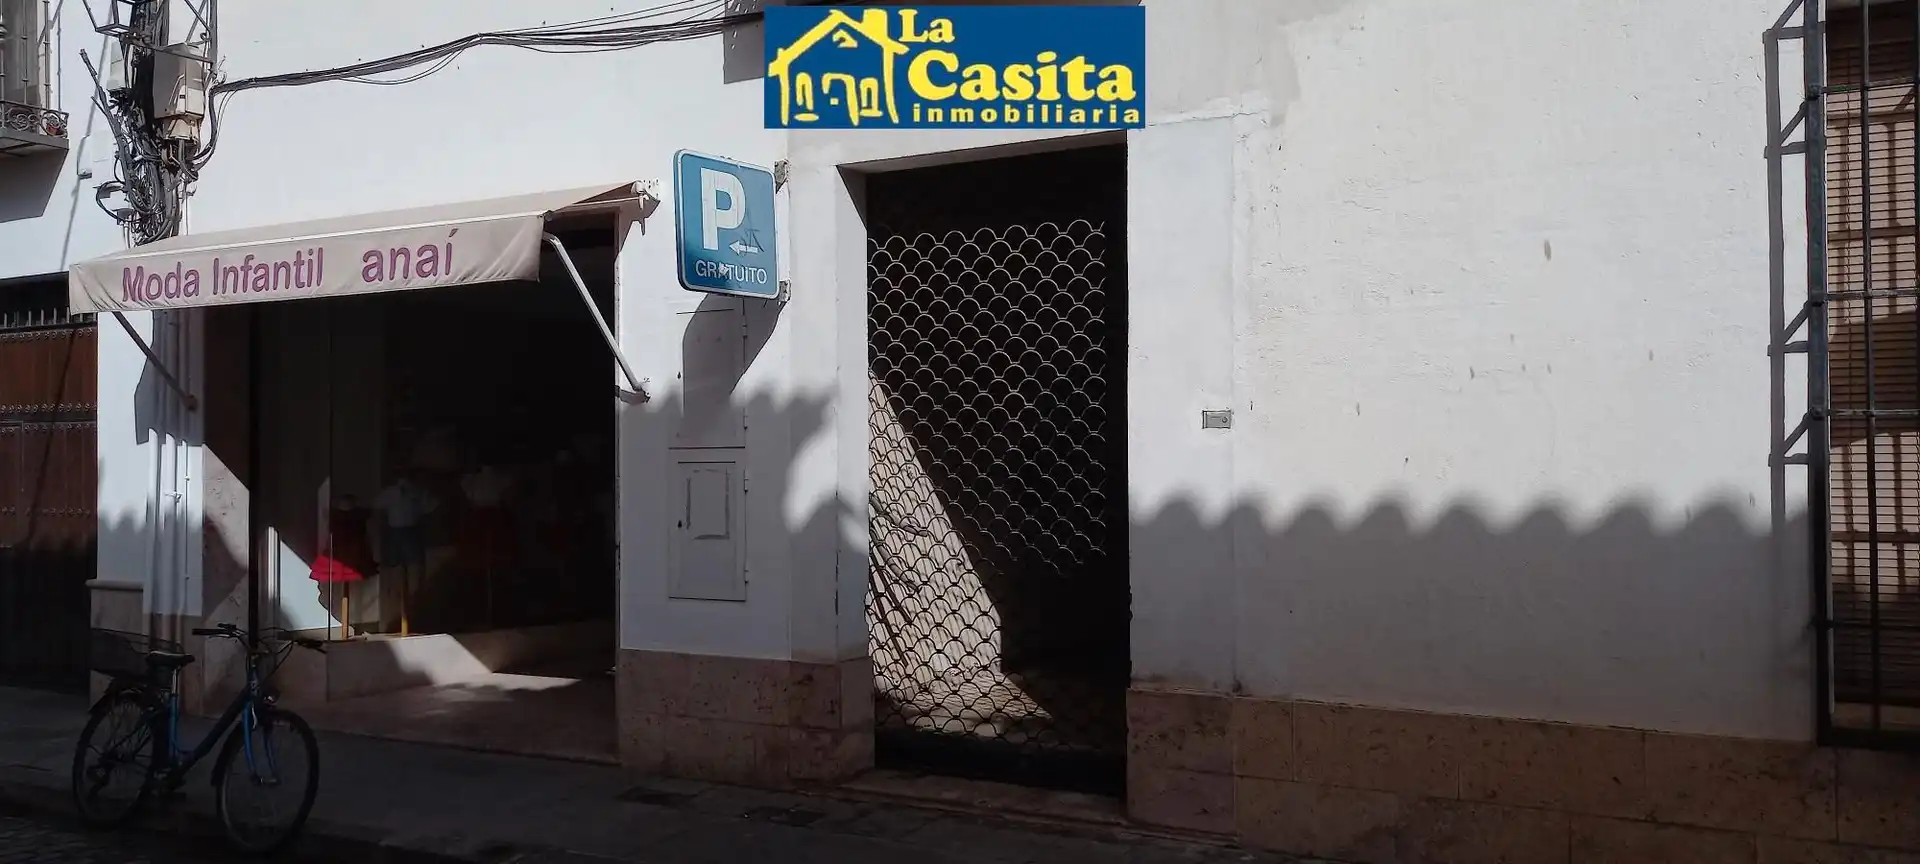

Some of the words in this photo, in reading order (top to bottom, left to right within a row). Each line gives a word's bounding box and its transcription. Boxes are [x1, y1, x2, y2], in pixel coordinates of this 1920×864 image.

[700, 167, 746, 250] P
[122, 261, 200, 302] Moda
[213, 247, 324, 295] Infantil
[362, 228, 459, 283] anaí
